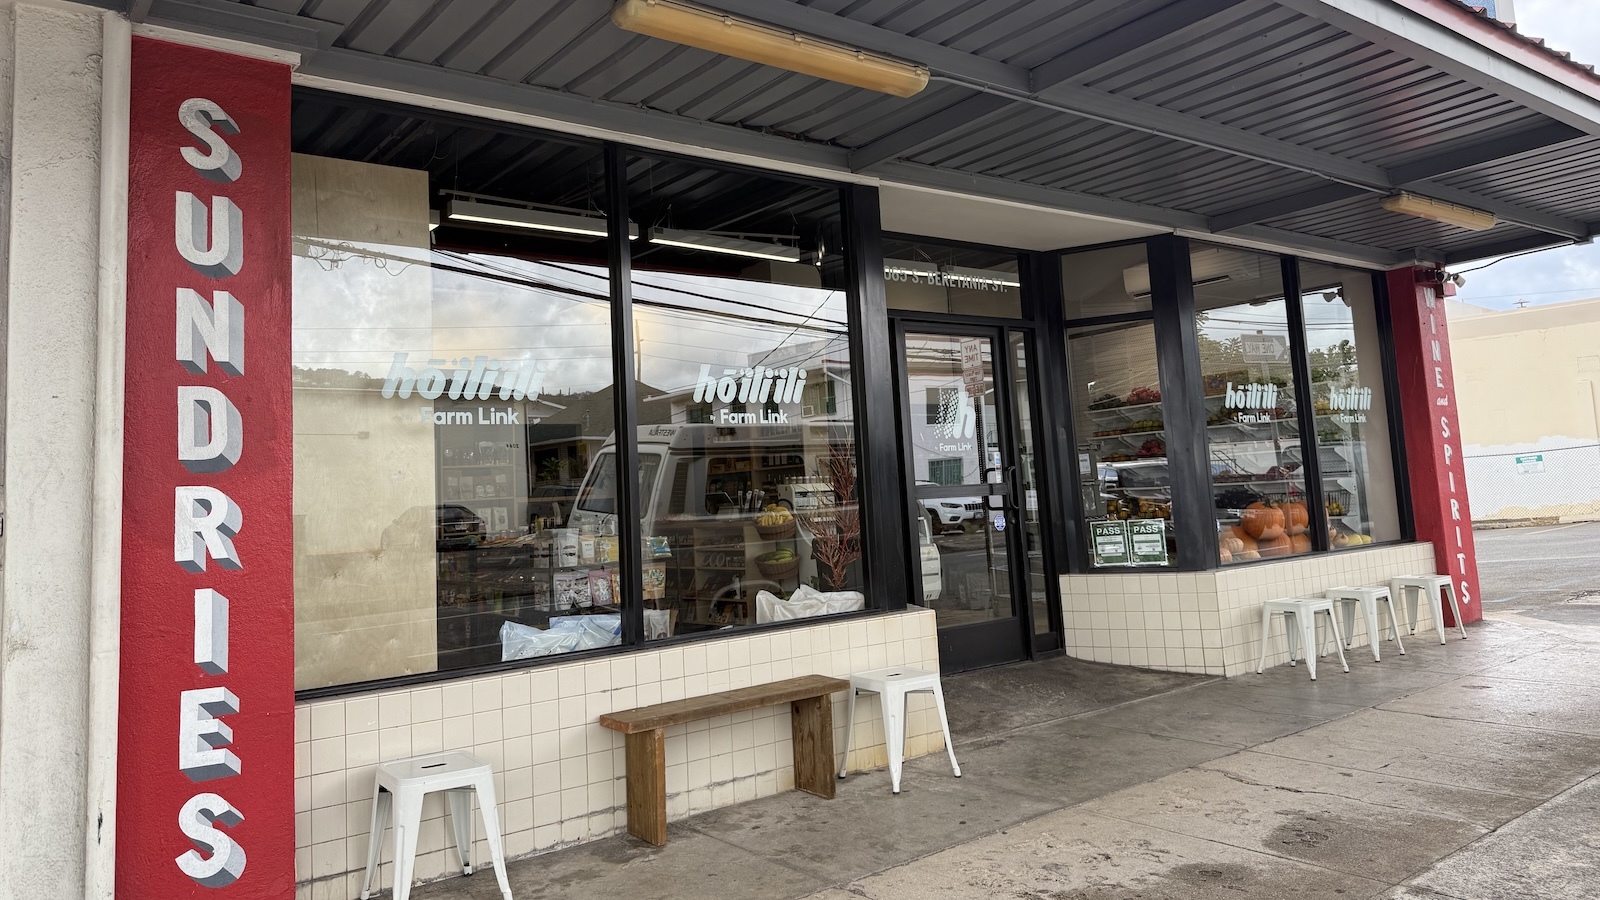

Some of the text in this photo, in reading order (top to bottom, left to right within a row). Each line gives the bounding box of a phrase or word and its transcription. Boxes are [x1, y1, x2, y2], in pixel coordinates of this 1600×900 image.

[912, 267, 924, 285] S.
[928, 270, 989, 291] BERETANIA
[991, 277, 1008, 293] ST.
[420, 406, 473, 425] Farm
[478, 407, 520, 426] Link
[720, 408, 757, 425] Farm
[760, 409, 789, 425] Link
[1237, 411, 1256, 423] Farm
[1256, 412, 1272, 424] Link
[1340, 413, 1367, 423] Farm Link
[939, 442, 973, 452] Farm Link
[1423, 287, 1471, 604] WINE and SPIRITS
[175, 98, 246, 888] SUNDRIES
[1096, 527, 1121, 535] PASS
[1133, 525, 1158, 533] PASS
